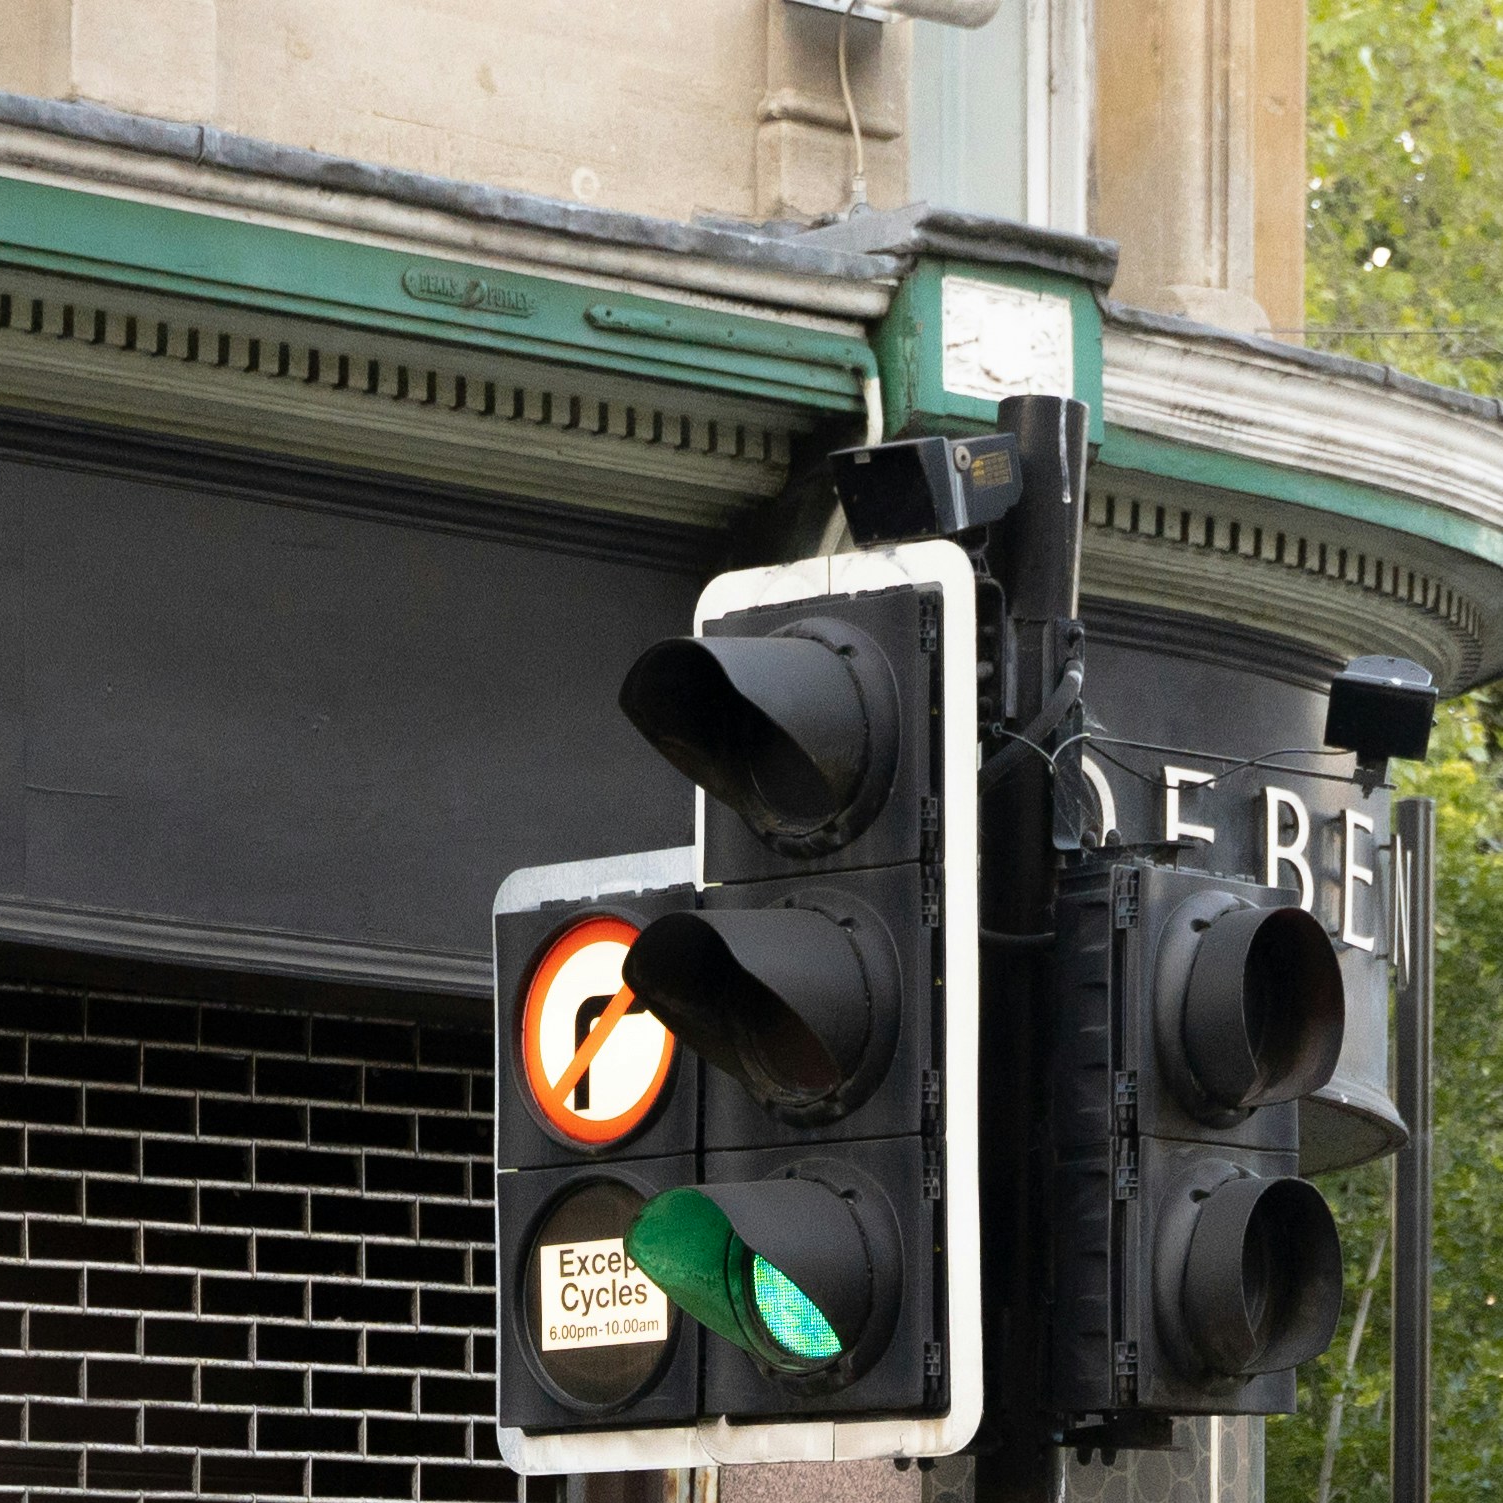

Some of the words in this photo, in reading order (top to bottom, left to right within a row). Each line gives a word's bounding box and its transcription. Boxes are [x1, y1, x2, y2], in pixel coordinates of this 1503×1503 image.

[560, 1249, 637, 1279] Excep
[561, 1279, 647, 1317] Cycles
[549, 1318, 659, 1341] 6.00pm-10.00am
